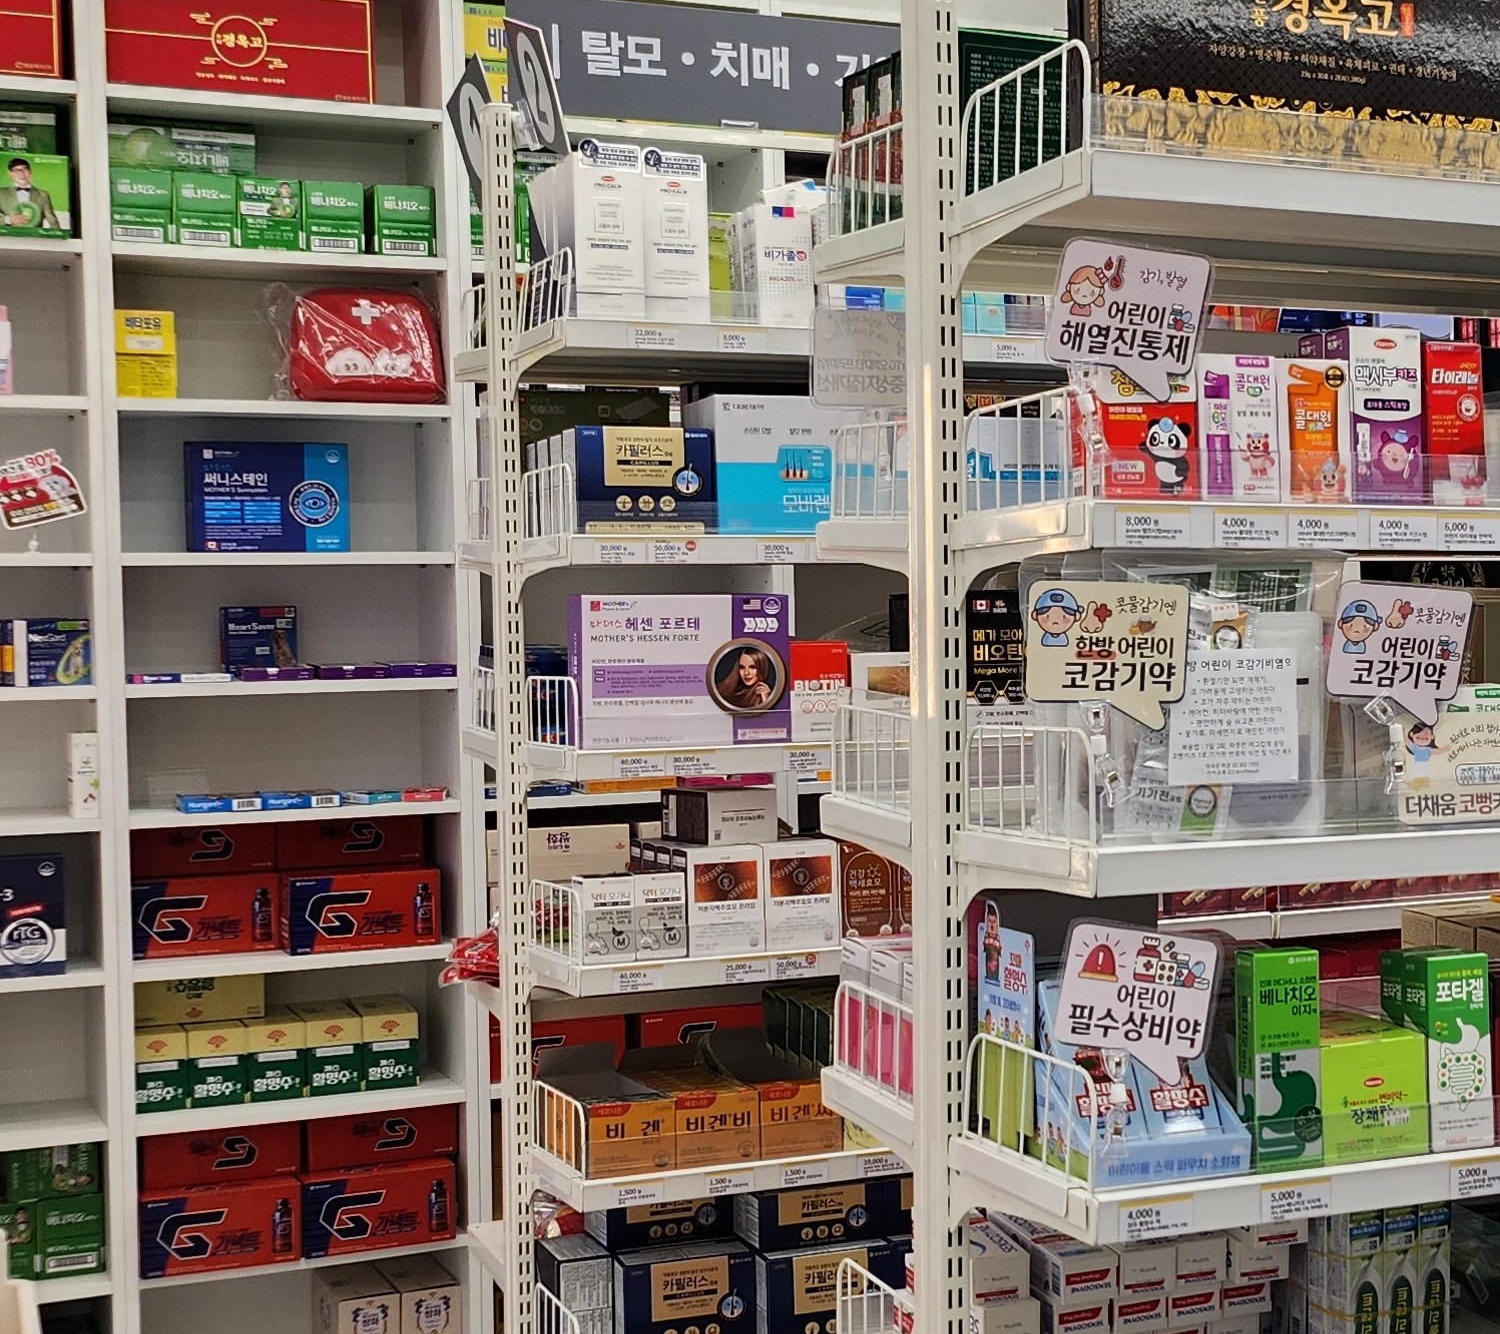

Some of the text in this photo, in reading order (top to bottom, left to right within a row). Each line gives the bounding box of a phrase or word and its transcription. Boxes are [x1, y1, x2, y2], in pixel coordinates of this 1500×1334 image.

[582, 31, 667, 77] 탈모
[711, 41, 791, 90] 치매
[528, 57, 550, 135] 2
[1107, 300, 1167, 331] 어린이
[1059, 319, 1192, 367] 해열진통제
[1235, 372, 1272, 391] 콜대원
[1294, 408, 1333, 429] 콜대원
[616, 444, 665, 458] 카필러스
[203, 471, 270, 488] 써니스테인
[1115, 595, 1177, 616] 콧물감기엔
[622, 618, 701, 632] 헤센 포르테
[589, 634, 700, 643] MOTHER'S HESSEN FORTE
[1075, 635, 1175, 659] 한방 어린이
[1381, 636, 1434, 658] 어린이
[1200, 659, 1232, 671] 어린이
[1350, 659, 1447, 691] 코감기약
[794, 678, 846, 693] BIOTIN
[1062, 661, 1177, 693] 코감기약
[1405, 793, 1456, 817] 더채움
[1116, 983, 1177, 1014] 어린이
[1259, 985, 1318, 1005] 베나치오
[1434, 979, 1485, 1004] 포타겔
[1067, 1002, 1202, 1049] 필수상비약
[1149, 1083, 1210, 1112] 활명수
[663, 1273, 709, 1291] 카필러스
